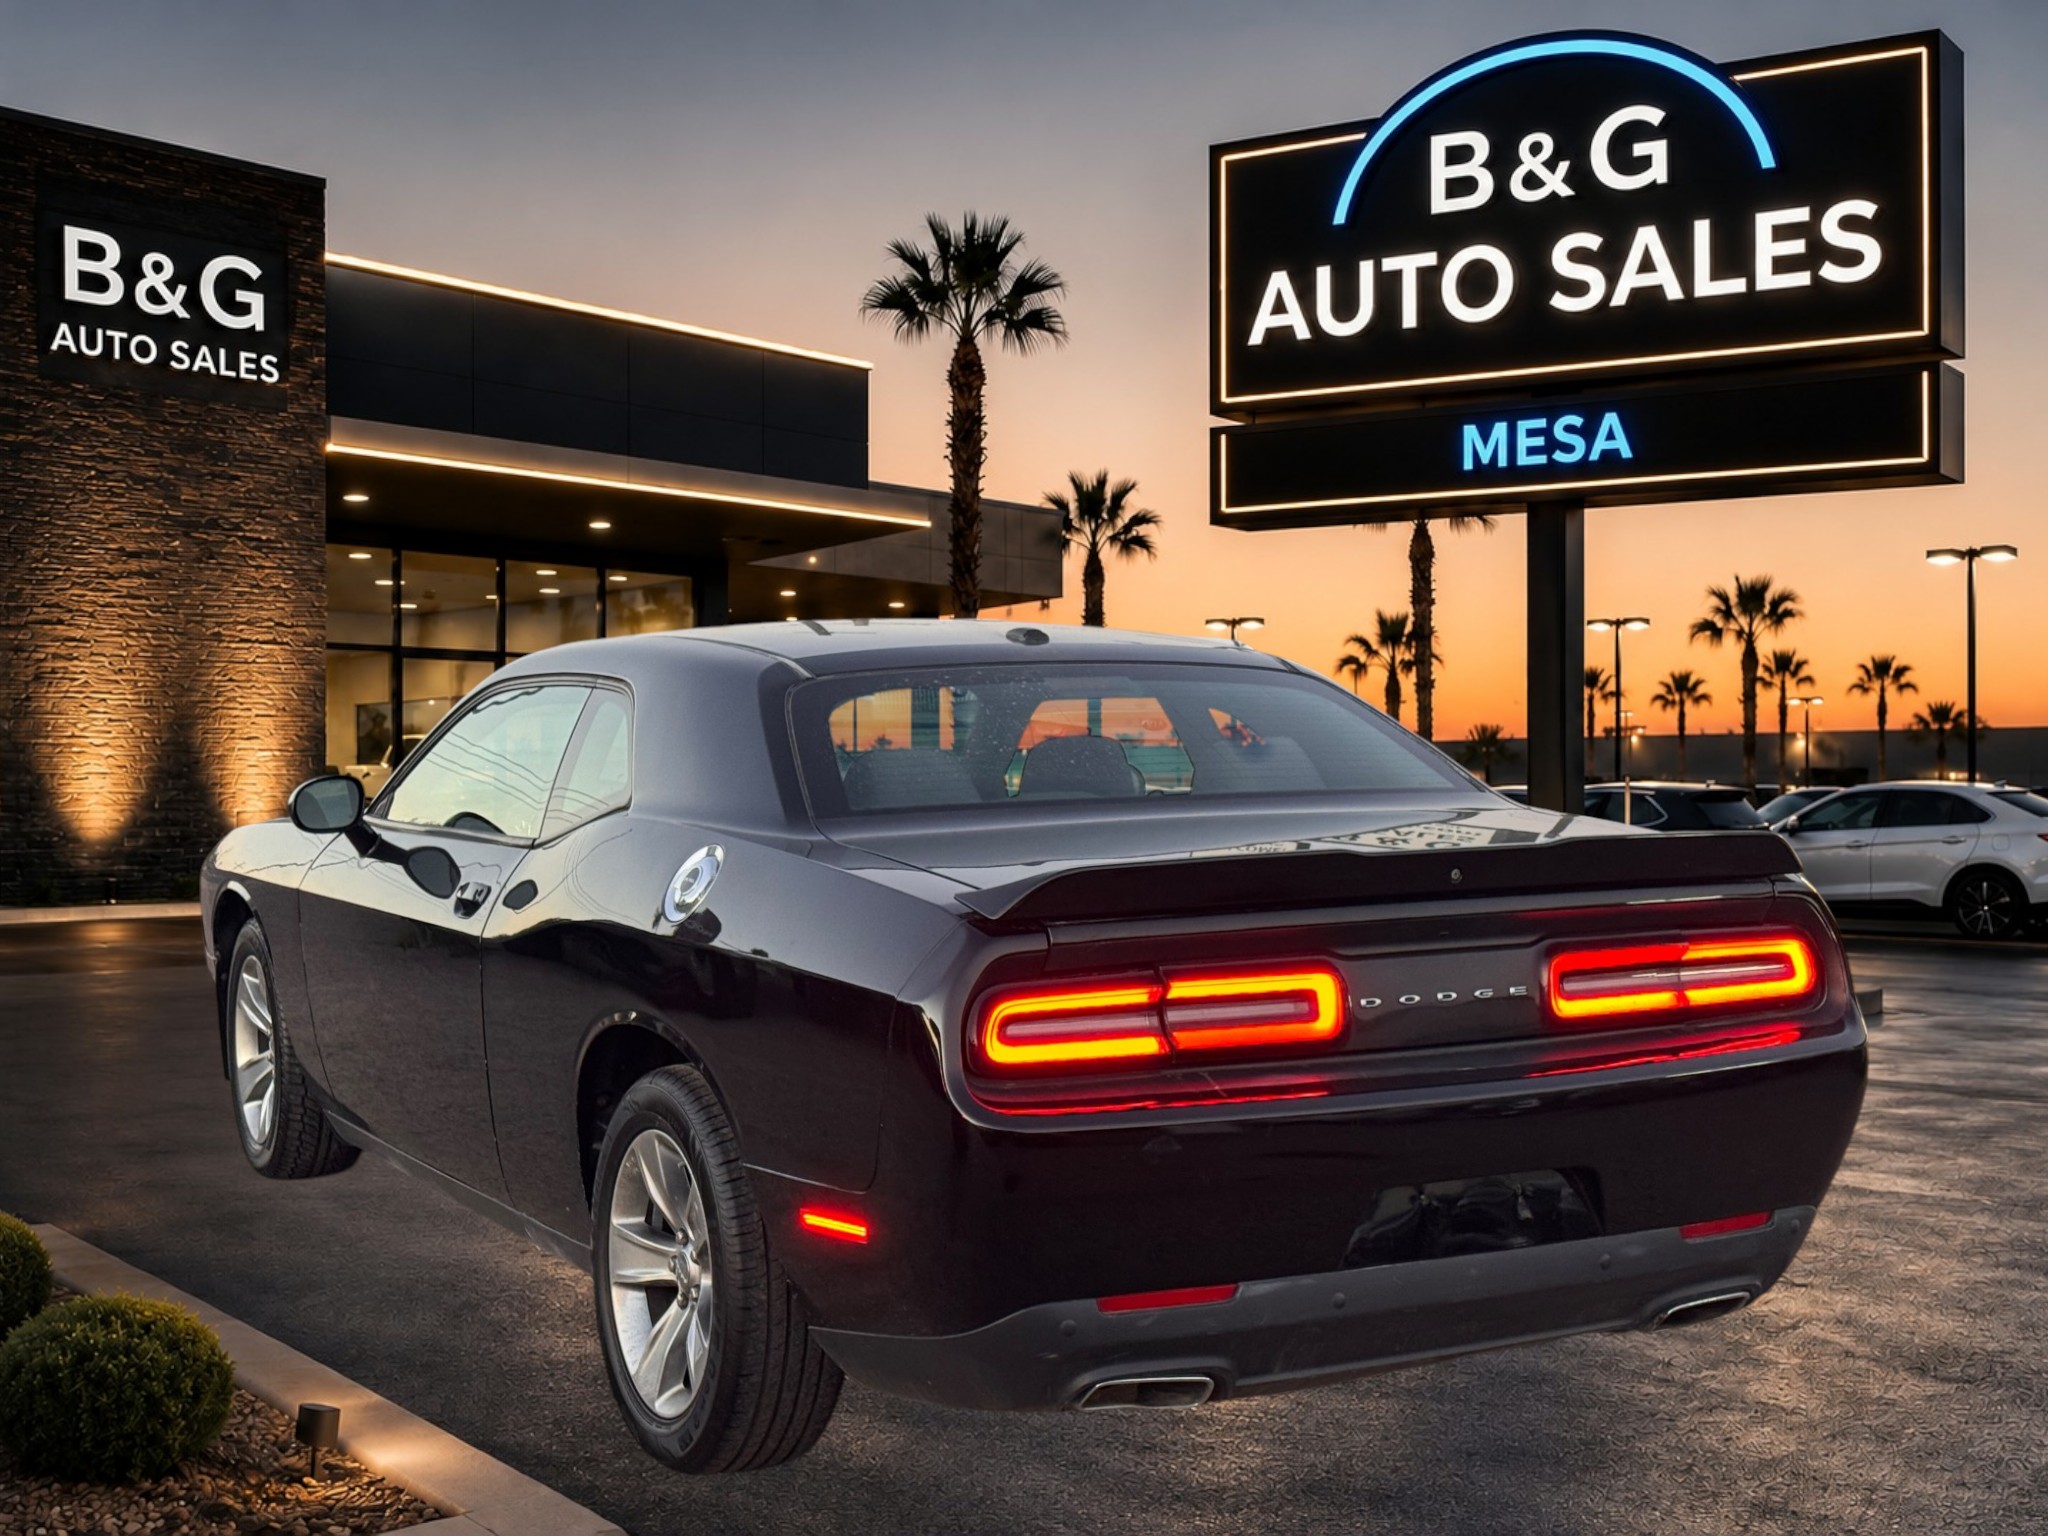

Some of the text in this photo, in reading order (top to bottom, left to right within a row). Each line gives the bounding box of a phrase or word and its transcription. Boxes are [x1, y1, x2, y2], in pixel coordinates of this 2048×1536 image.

[64, 224, 265, 332] B&G
[1247, 199, 1882, 346] AUTO SALES
[50, 322, 281, 384] AUTO SALES
[1462, 411, 1633, 471] MESA
[1359, 985, 1529, 1008] DODGE
